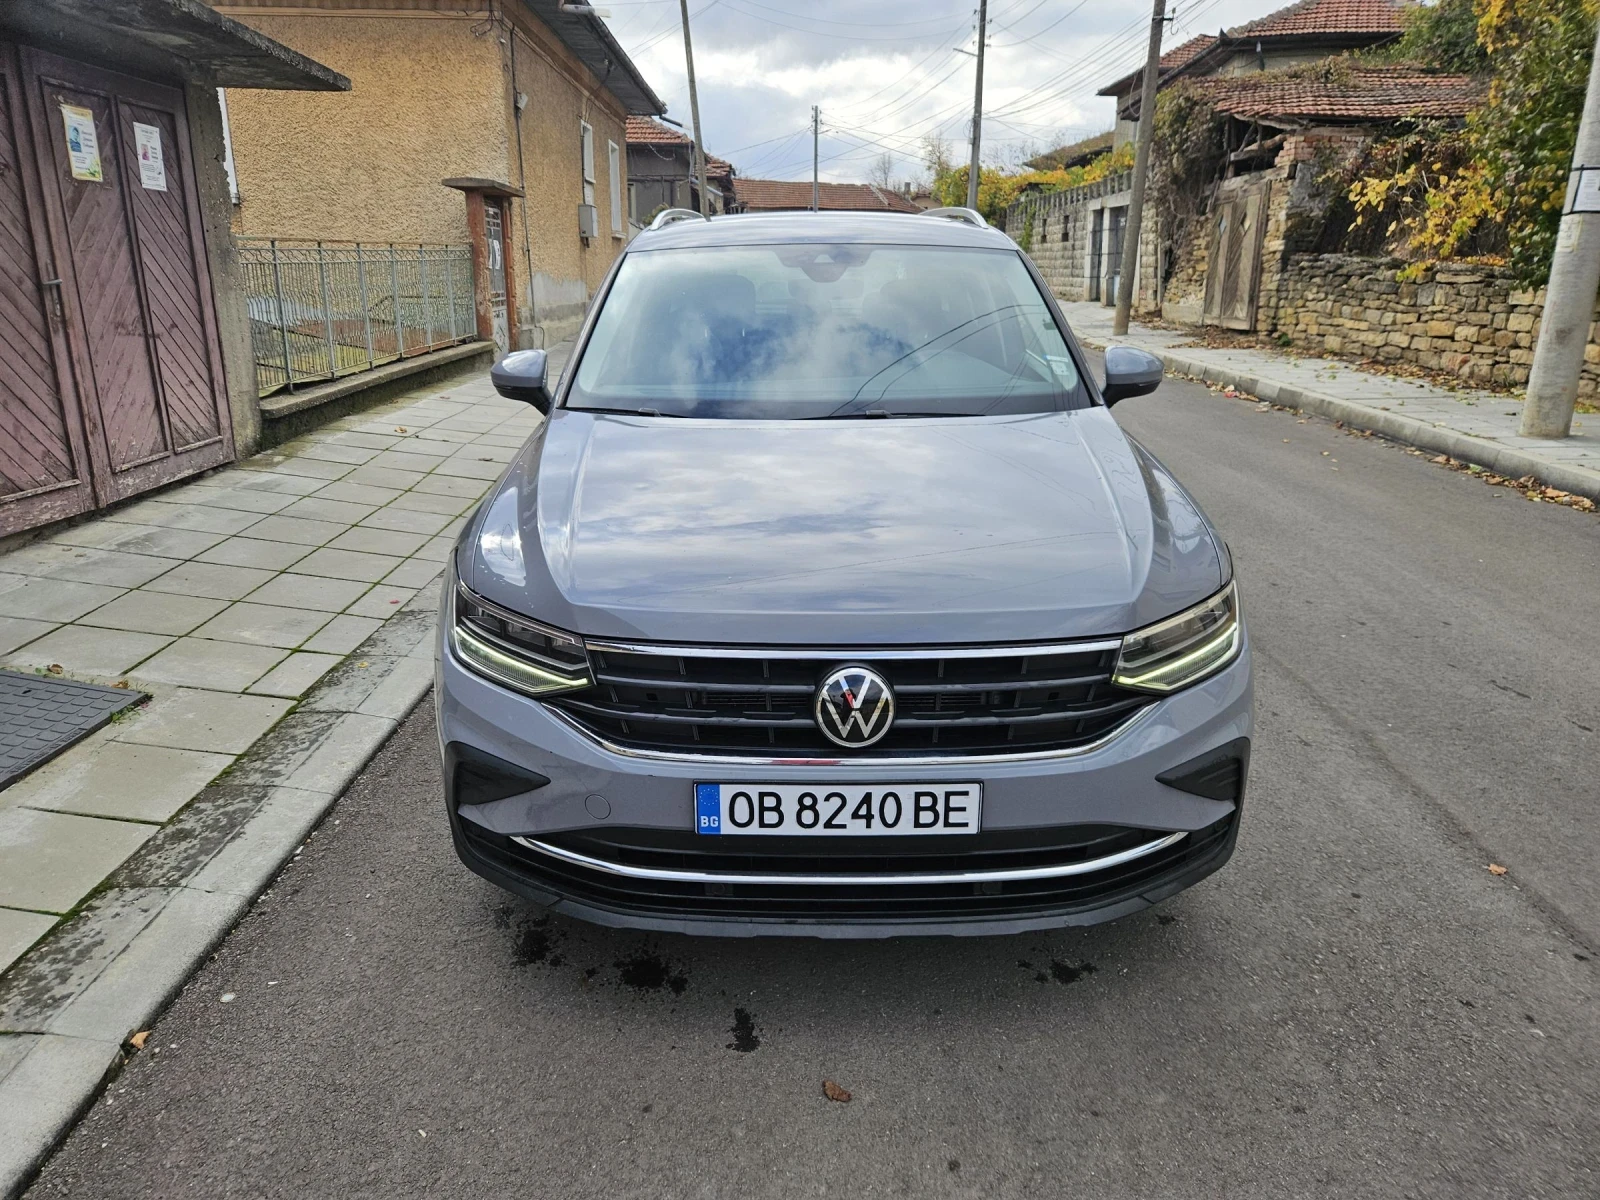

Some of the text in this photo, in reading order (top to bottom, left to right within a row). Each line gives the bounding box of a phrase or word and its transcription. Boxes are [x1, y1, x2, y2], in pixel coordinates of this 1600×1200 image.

[818, 669, 892, 743] VW
[700, 815, 719, 827] BG
[728, 790, 970, 829] OB 8240 BE
